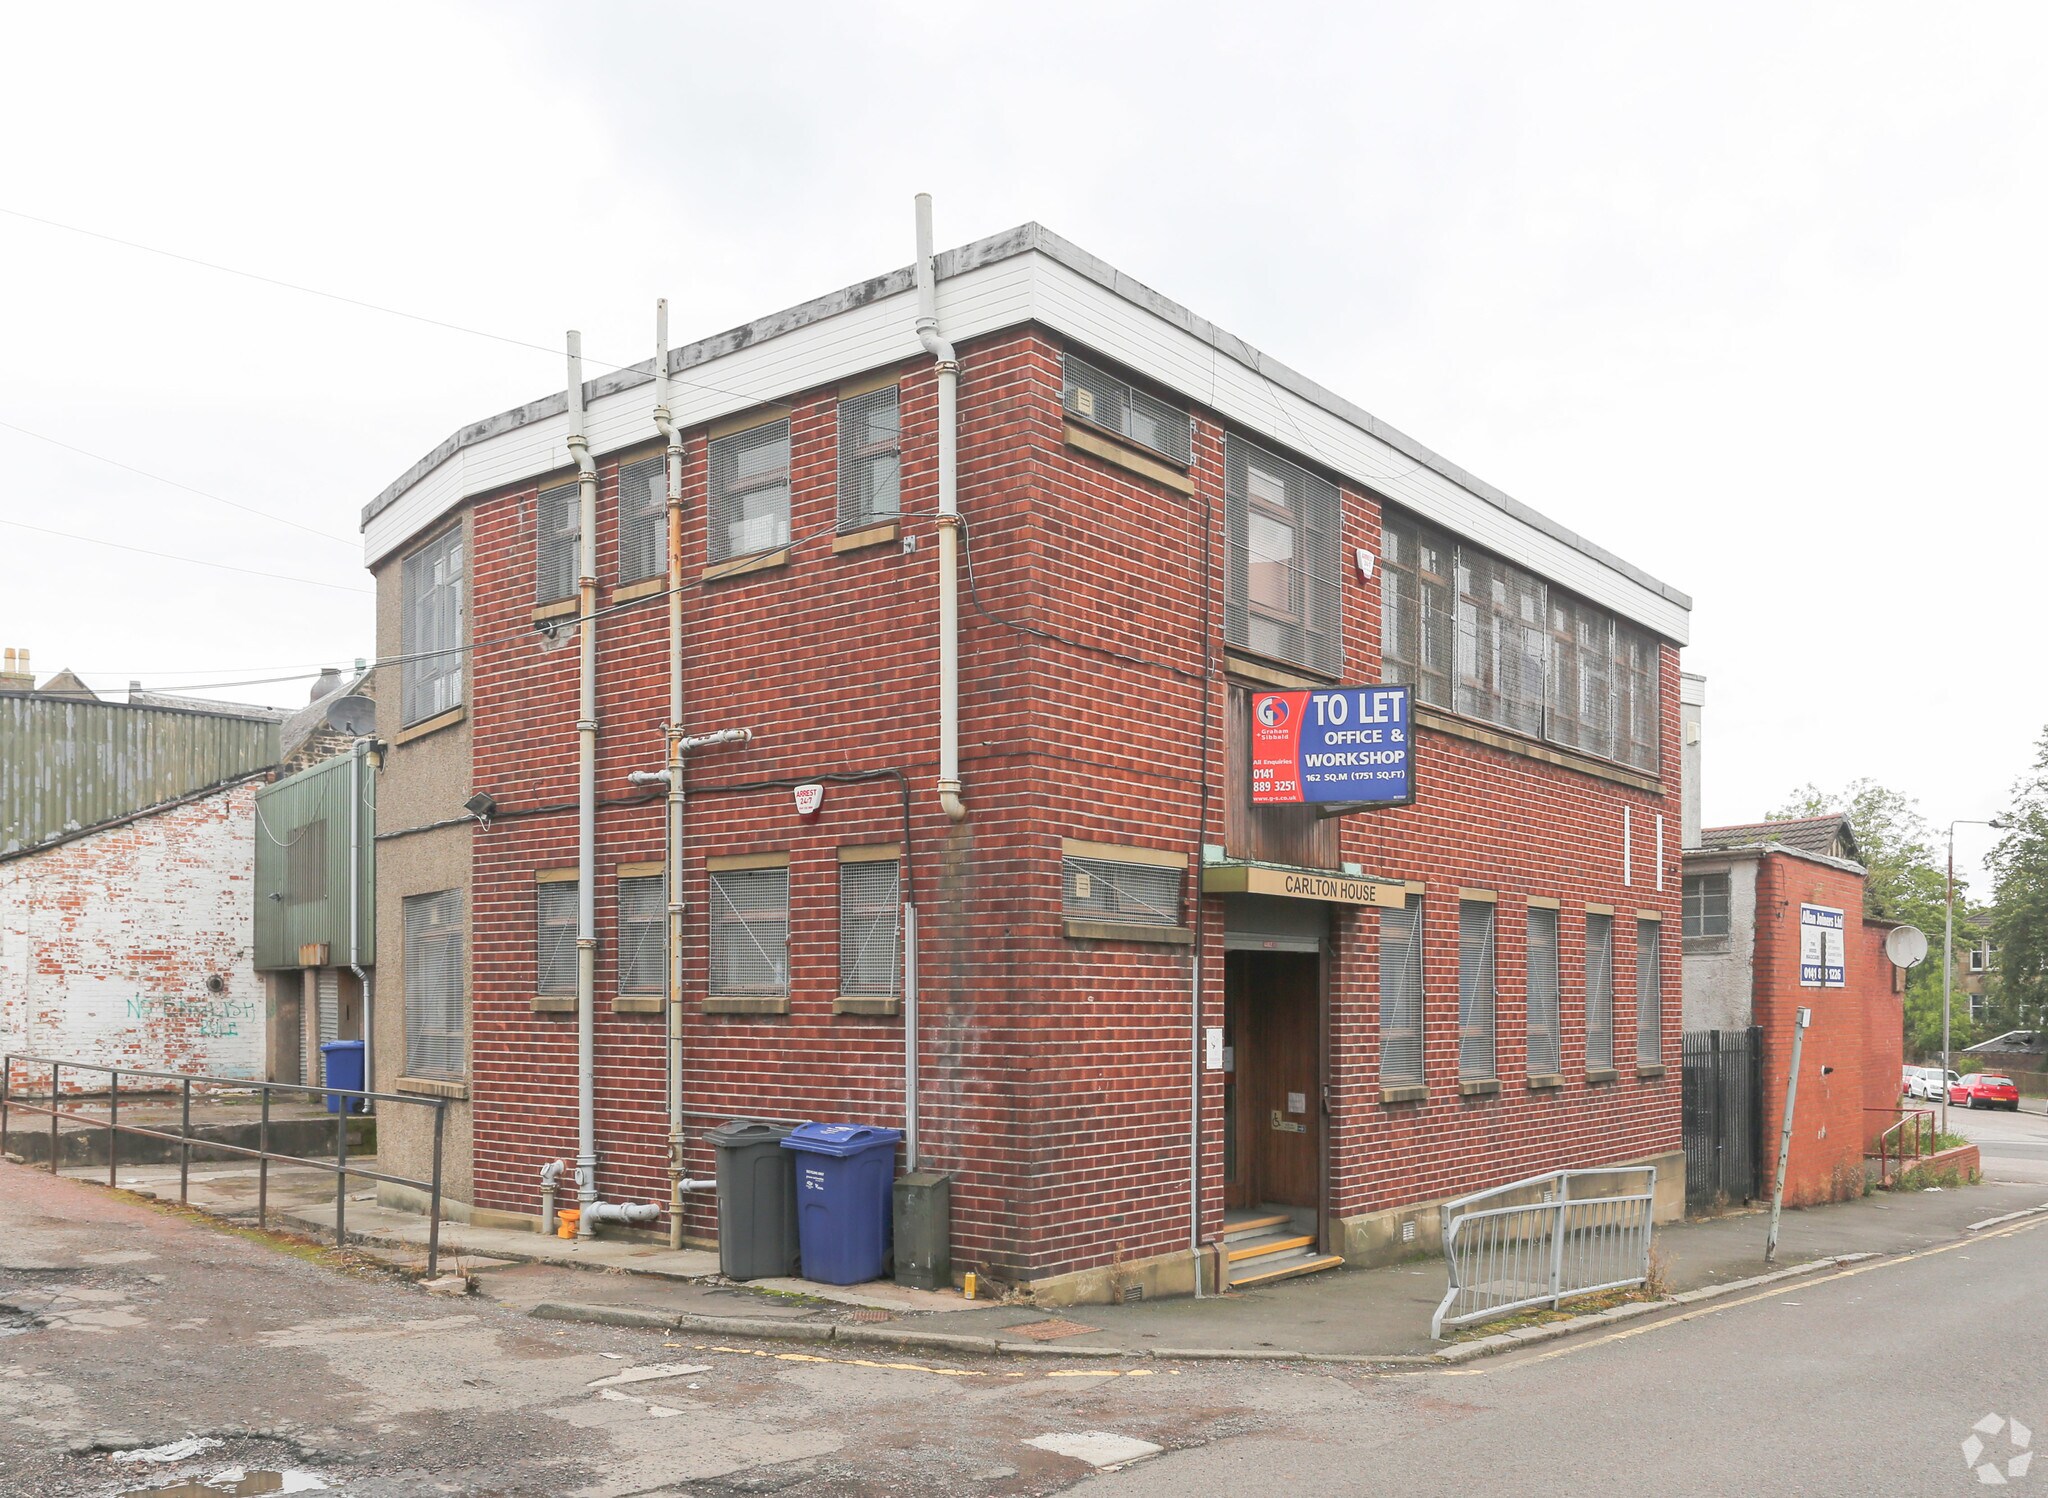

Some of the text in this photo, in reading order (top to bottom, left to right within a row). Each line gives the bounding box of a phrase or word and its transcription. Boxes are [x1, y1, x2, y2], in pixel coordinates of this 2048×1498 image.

[1313, 691, 1404, 726] TO LET
[1324, 728, 1405, 745] OFFICE &
[1263, 758, 1293, 766] Enquiries
[1305, 750, 1405, 767] WORKSHOP
[1253, 769, 1274, 779] 0141
[1306, 769, 1406, 782] 162 SQ.M (1751 SQ.FT)
[796, 789, 817, 797] ARREST
[1253, 781, 1296, 792] 889 3251
[1285, 875, 1376, 901] CARLTON HOUSE
[1803, 910, 1816, 925] Allan
[1817, 912, 1834, 927] Joiners
[1804, 967, 1817, 979] 0141
